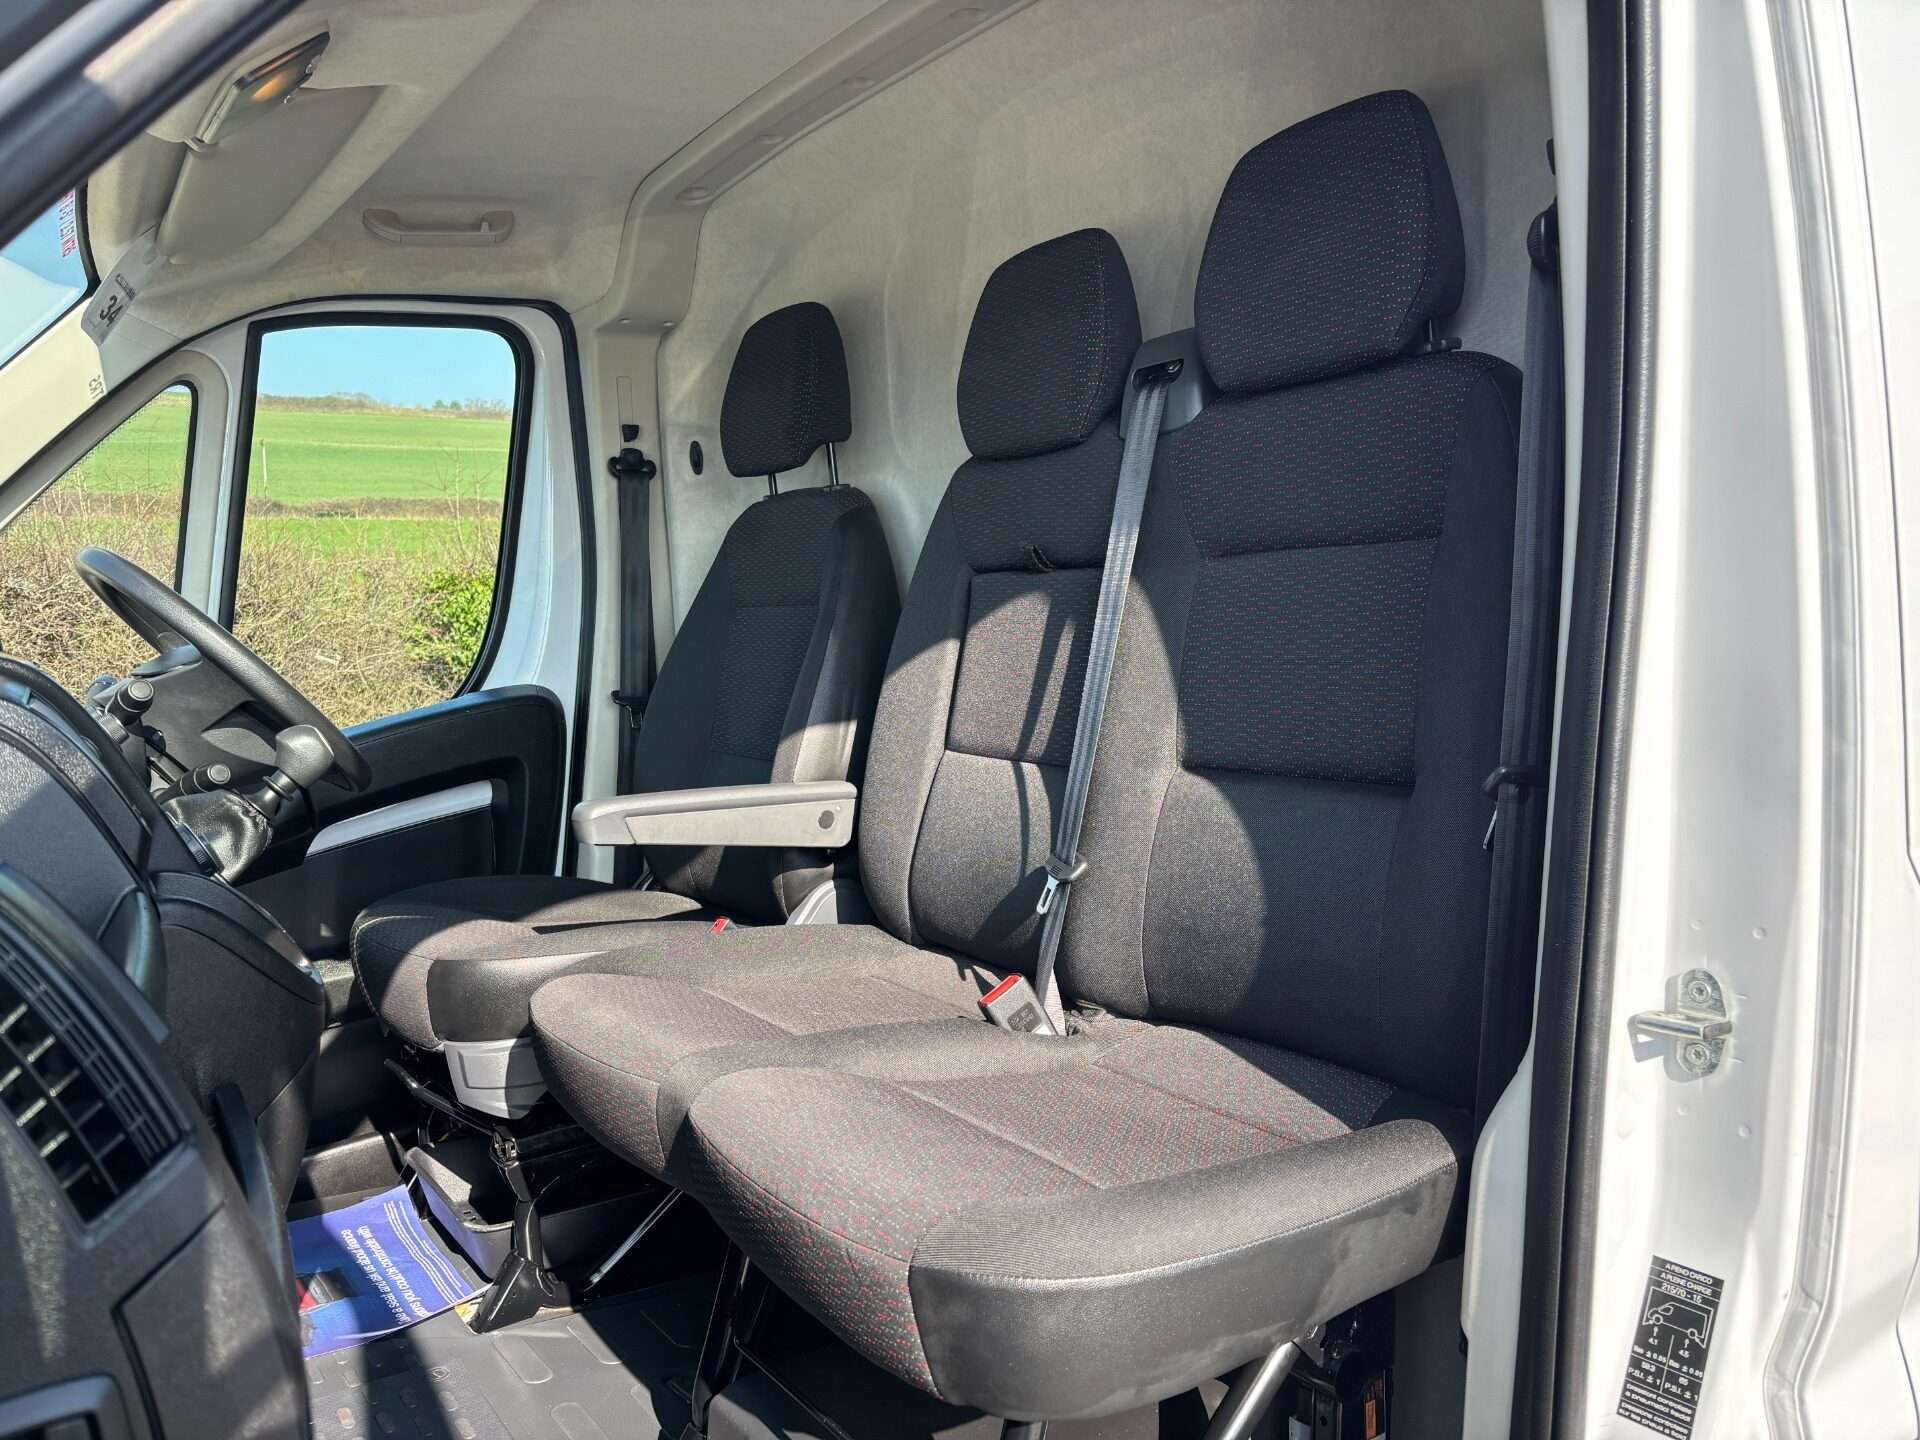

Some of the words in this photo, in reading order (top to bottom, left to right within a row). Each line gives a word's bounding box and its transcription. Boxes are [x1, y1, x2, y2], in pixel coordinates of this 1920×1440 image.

[100, 295, 123, 327] 34
[1662, 1283, 1686, 1297] 215/70
[1693, 1295, 1702, 1303] 15
